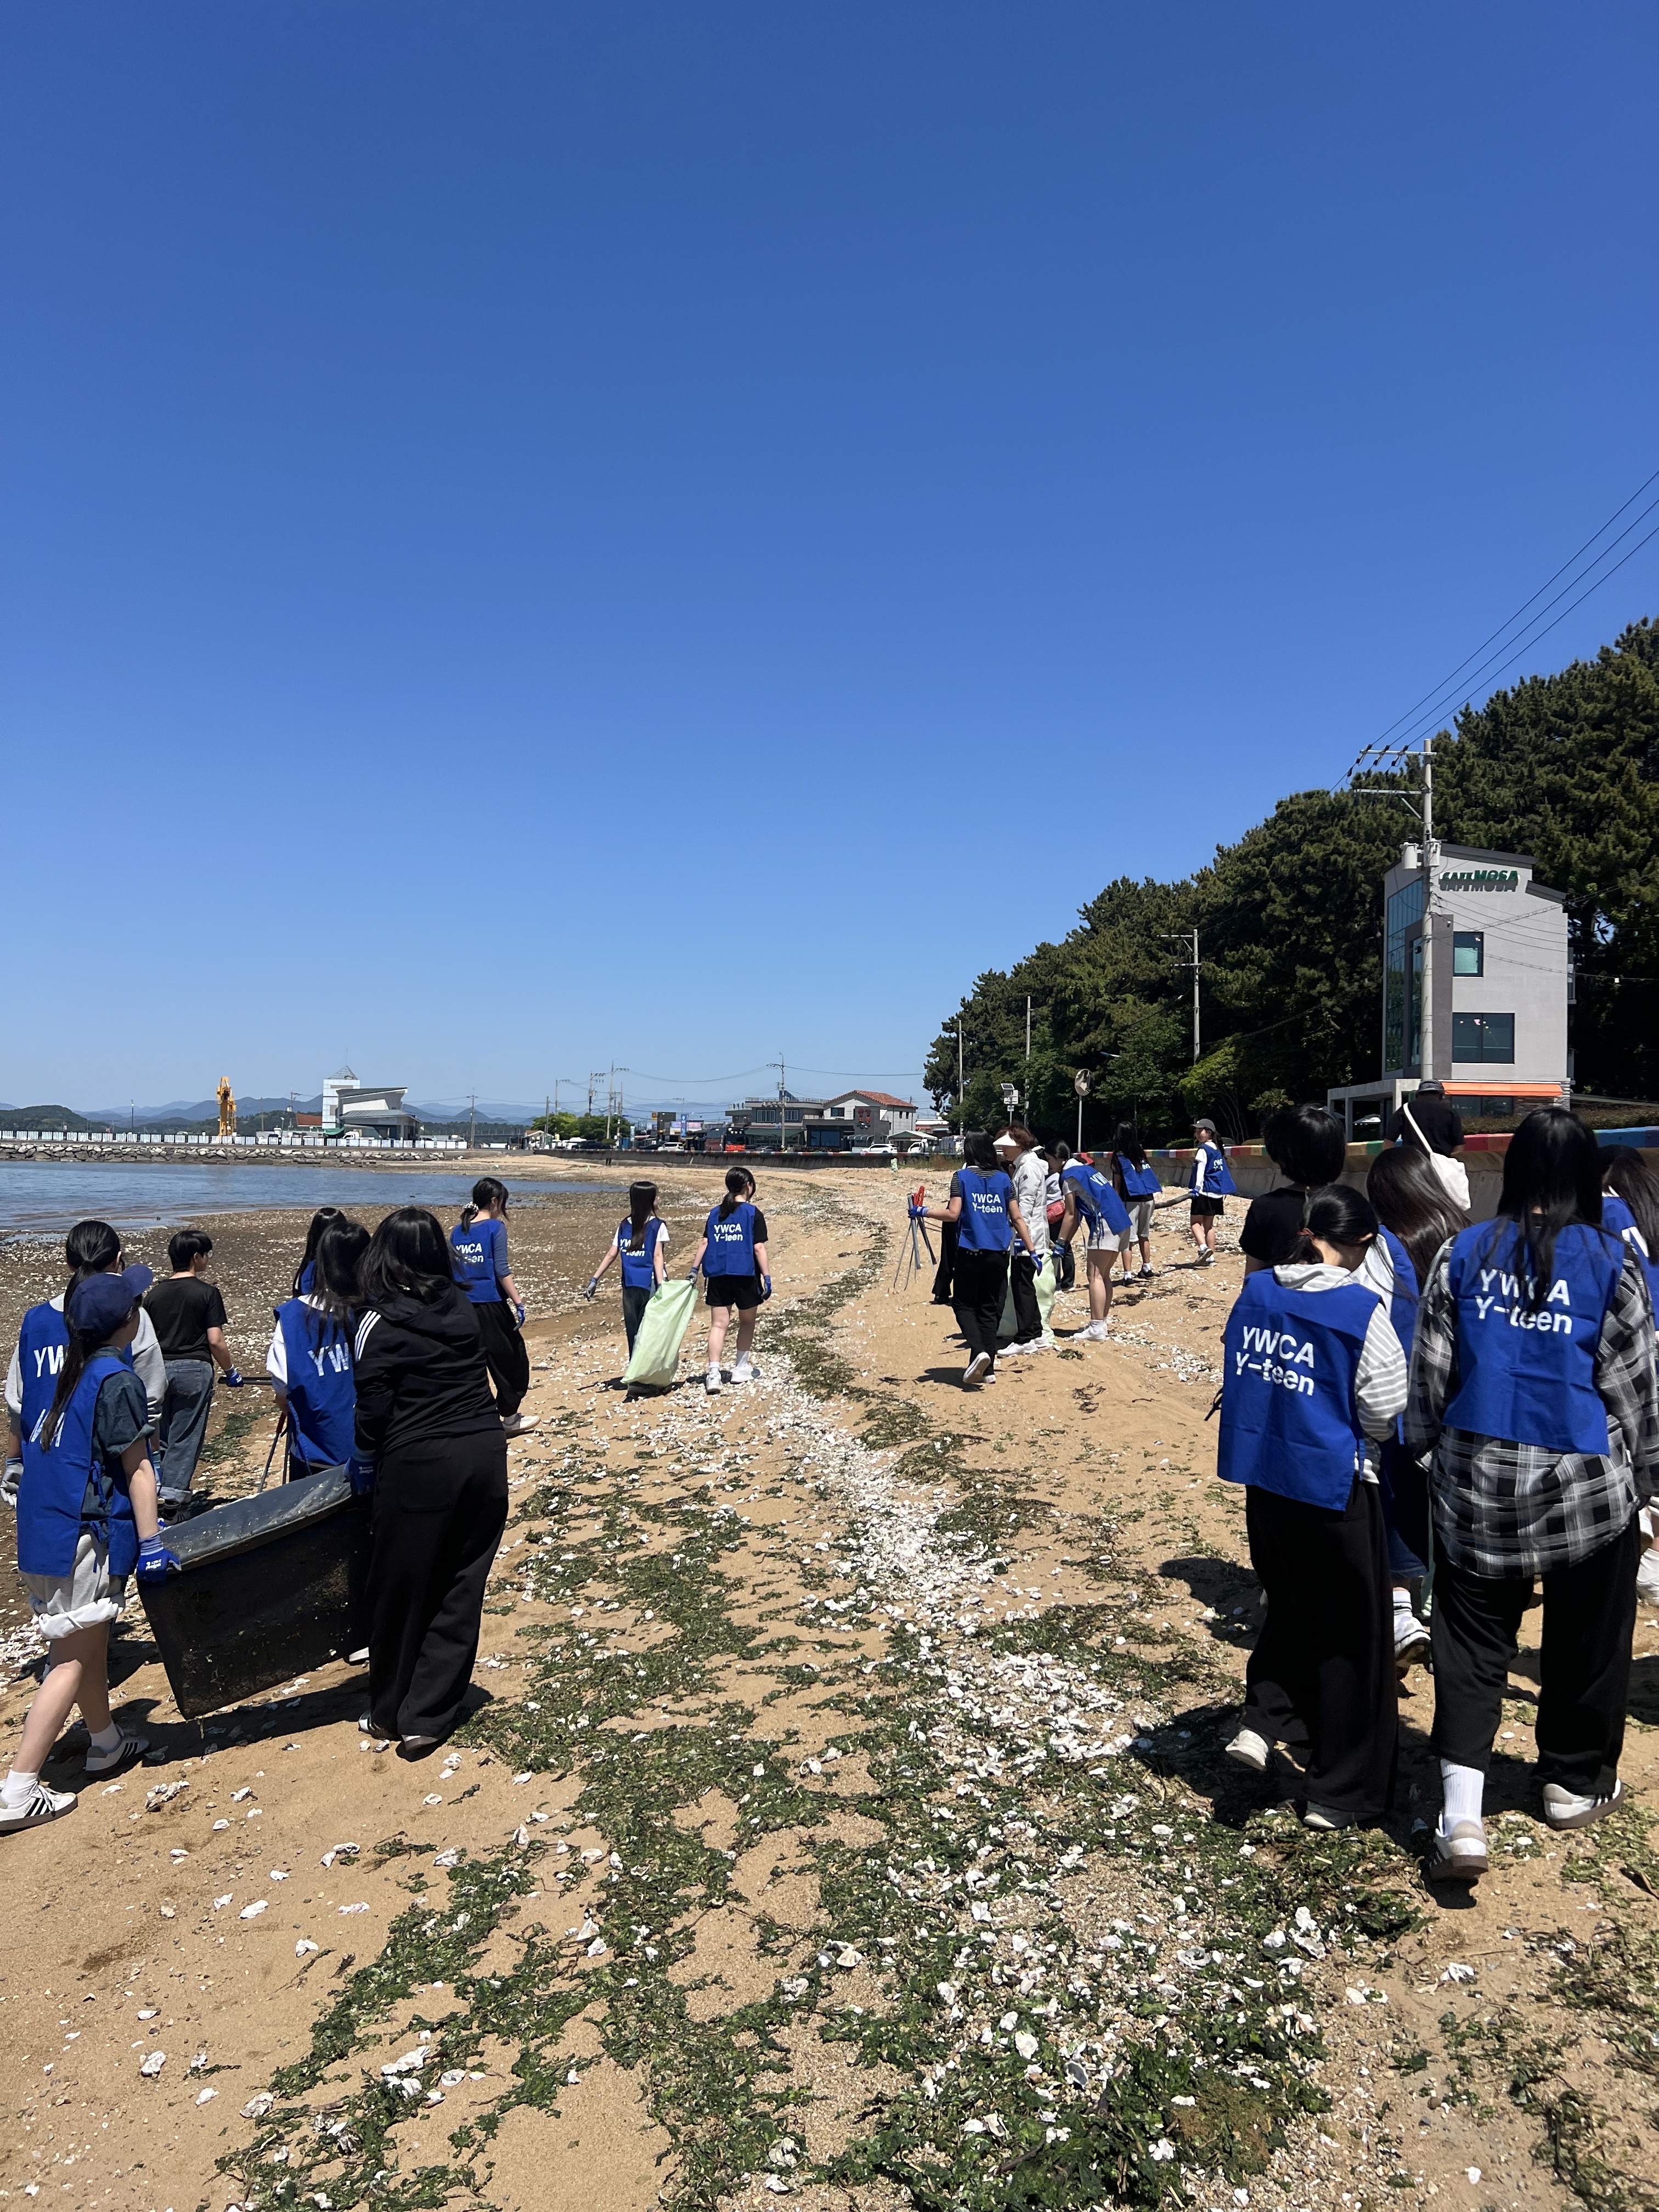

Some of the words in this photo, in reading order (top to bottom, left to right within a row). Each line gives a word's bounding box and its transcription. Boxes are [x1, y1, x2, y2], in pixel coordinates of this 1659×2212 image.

[1474, 870, 1518, 881] MOSA
[972, 1193, 1001, 1203] YWCA
[972, 1203, 1003, 1213] Y-teen
[714, 1223, 742, 1233] YWCA
[714, 1233, 743, 1242] Y-teen
[1475, 1295, 1572, 1334] Y-teen
[1243, 1326, 1314, 1368] YWCA
[33, 1345, 69, 1378] YW
[308, 1342, 349, 1376] YW
[1237, 1352, 1314, 1396] Y-teen
